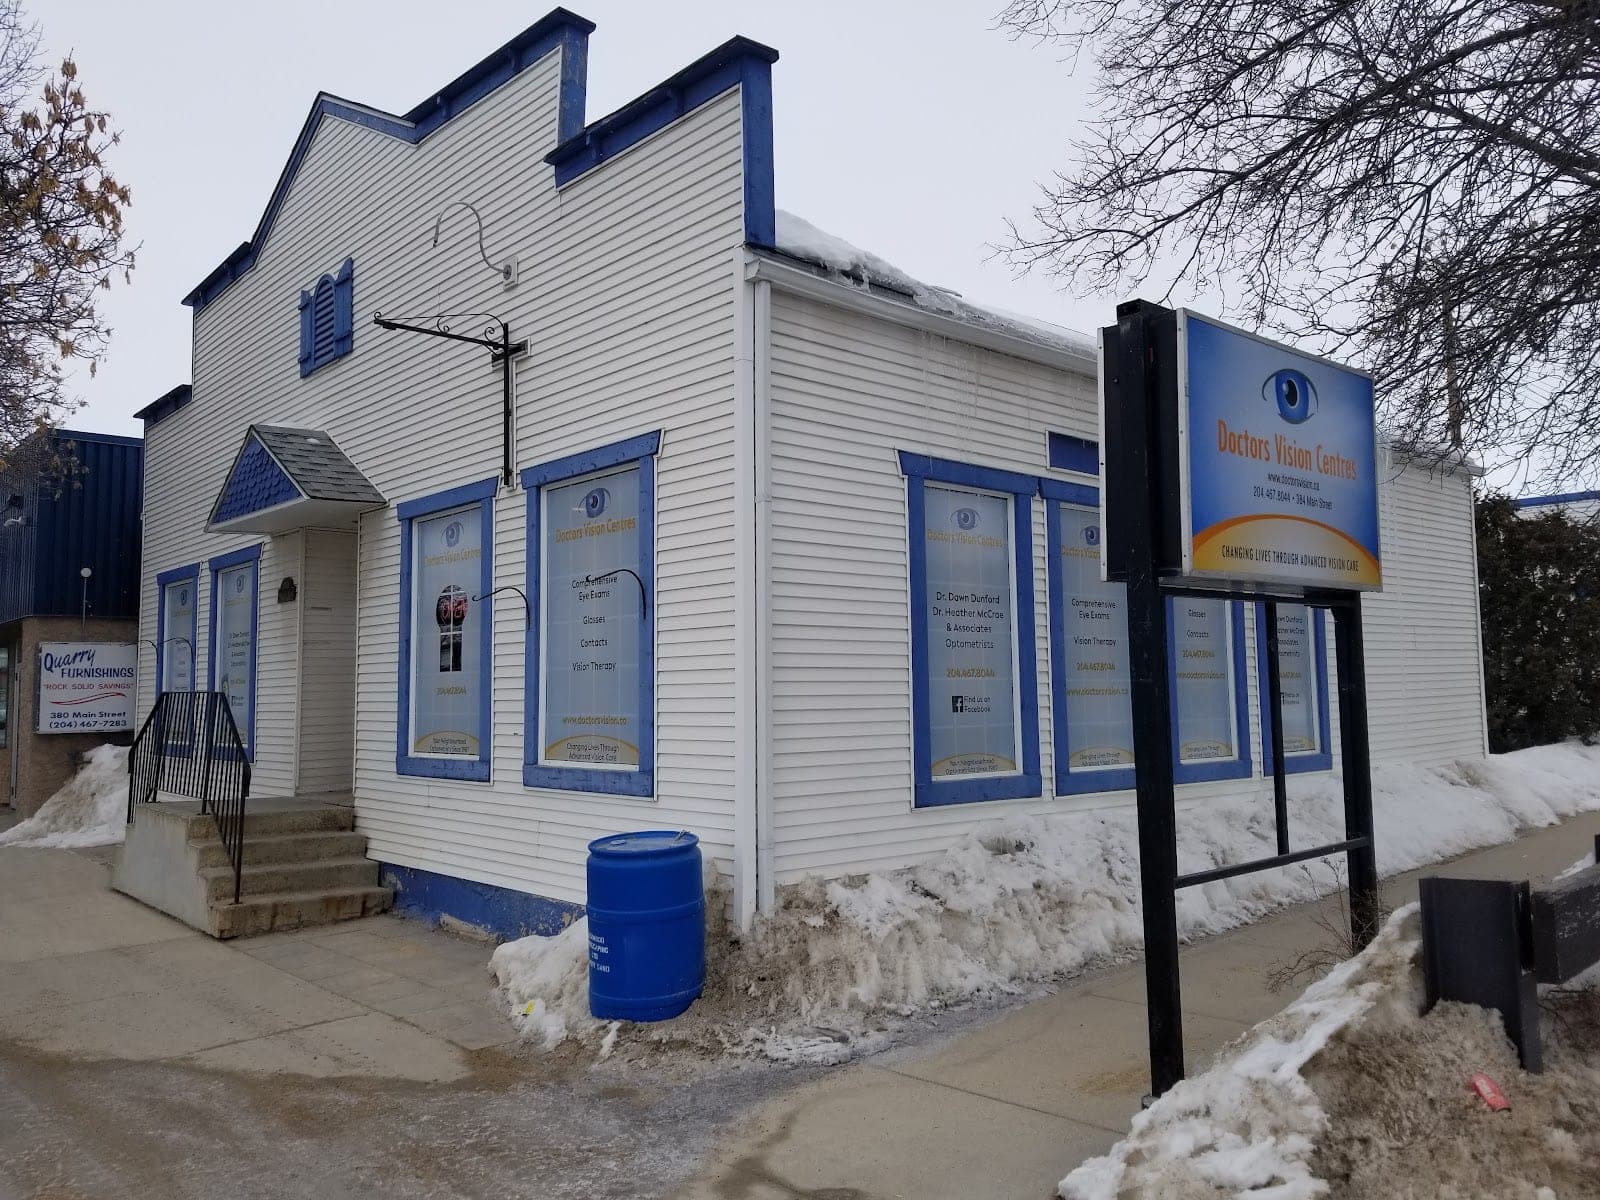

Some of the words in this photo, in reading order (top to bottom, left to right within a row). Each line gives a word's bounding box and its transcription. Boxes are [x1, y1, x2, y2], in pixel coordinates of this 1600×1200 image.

[1216, 418, 1270, 462] Doctors
[1274, 433, 1312, 471] Vision
[1315, 443, 1357, 481] Centres
[1253, 486, 1291, 503] 204.467.8044
[1306, 495, 1319, 508] Main
[1319, 498, 1333, 510] Street
[554, 526, 582, 544] Doctors
[583, 520, 605, 537] Vision
[606, 516, 637, 534] Centres
[927, 529, 954, 543] Doctors
[956, 531, 976, 545] Vision
[977, 533, 1003, 548] Centres
[1221, 545, 1254, 561] CHANGING
[1255, 548, 1271, 562] LIVES
[1273, 551, 1299, 566] THROUGH
[1300, 553, 1327, 569] ADVANCED
[1328, 557, 1346, 571] VISION
[1346, 559, 1360, 572] CARE
[571, 576, 618, 589] Comprehensive
[579, 591, 589, 602] Eye
[590, 590, 610, 600] Exams
[936, 591, 947, 601] Dr.
[948, 592, 969, 602] Dawn
[970, 593, 1000, 604] Dunford
[1071, 598, 1117, 609] Comprehensive
[932, 606, 944, 616] Dr.
[945, 607, 976, 618] Heather
[977, 609, 1004, 619] McCrae
[1079, 610, 1090, 620] Eye
[1090, 610, 1110, 620] Exams
[582, 615, 606, 625] Glasses
[946, 622, 952, 632] &
[953, 624, 992, 633] Associates
[580, 638, 608, 648] Contacts
[945, 638, 995, 650] Optometrists
[1073, 635, 1092, 645] Vision
[1093, 636, 1117, 647] Therapy
[43, 648, 96, 673] Quarry
[572, 662, 590, 671] Vision
[590, 661, 617, 672] Therapy
[60, 667, 134, 679] FURNISHINGS
[72, 711, 96, 719] Main
[964, 705, 991, 713] Facebook
[49, 721, 77, 729] (204)
[80, 719, 127, 729] 467-7283
